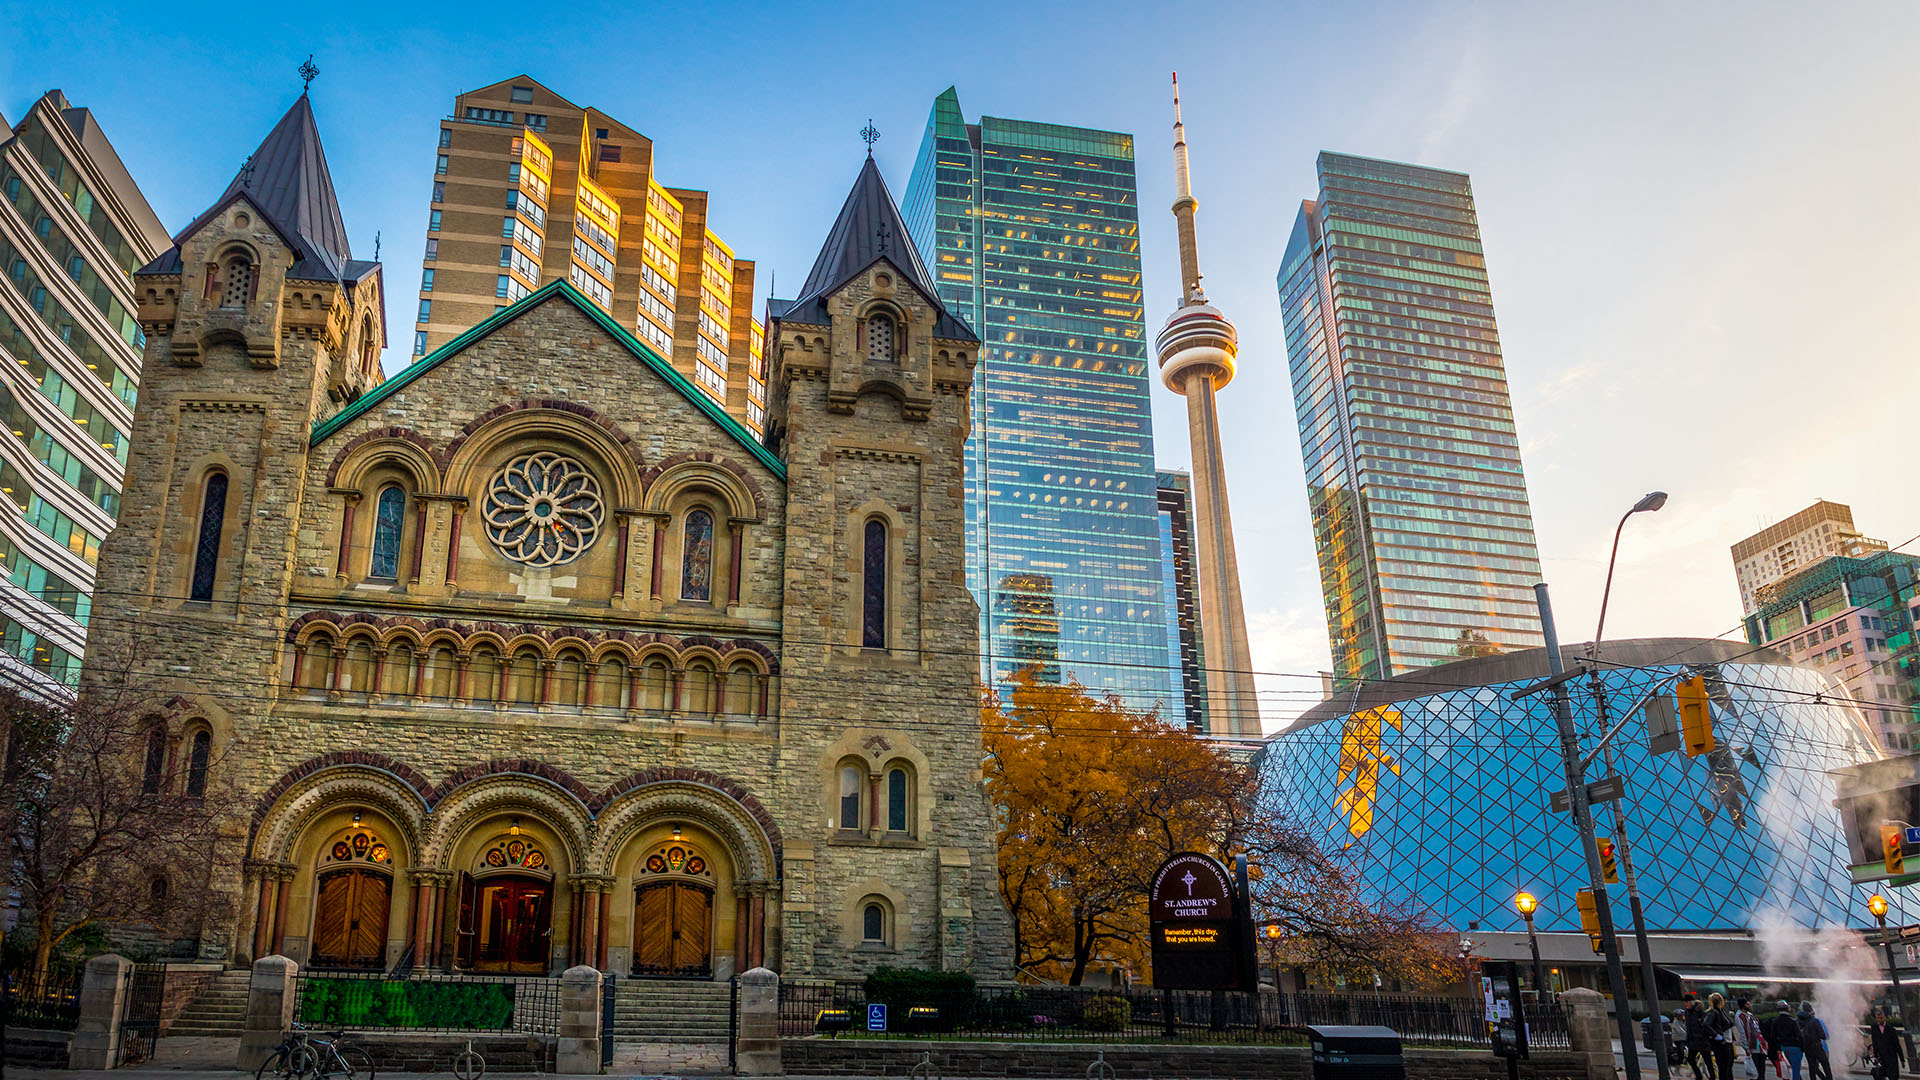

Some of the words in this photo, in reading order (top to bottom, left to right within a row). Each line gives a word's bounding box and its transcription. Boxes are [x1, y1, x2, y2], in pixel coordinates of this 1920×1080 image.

[1155, 856, 1187, 888] PRESBYTERIAN
[1186, 856, 1211, 868] CHURCH
[1215, 870, 1229, 898] CANADA
[1174, 908, 1208, 917] CHURCH
[1164, 928, 1194, 936] Remember,
[1177, 936, 1188, 944] you
